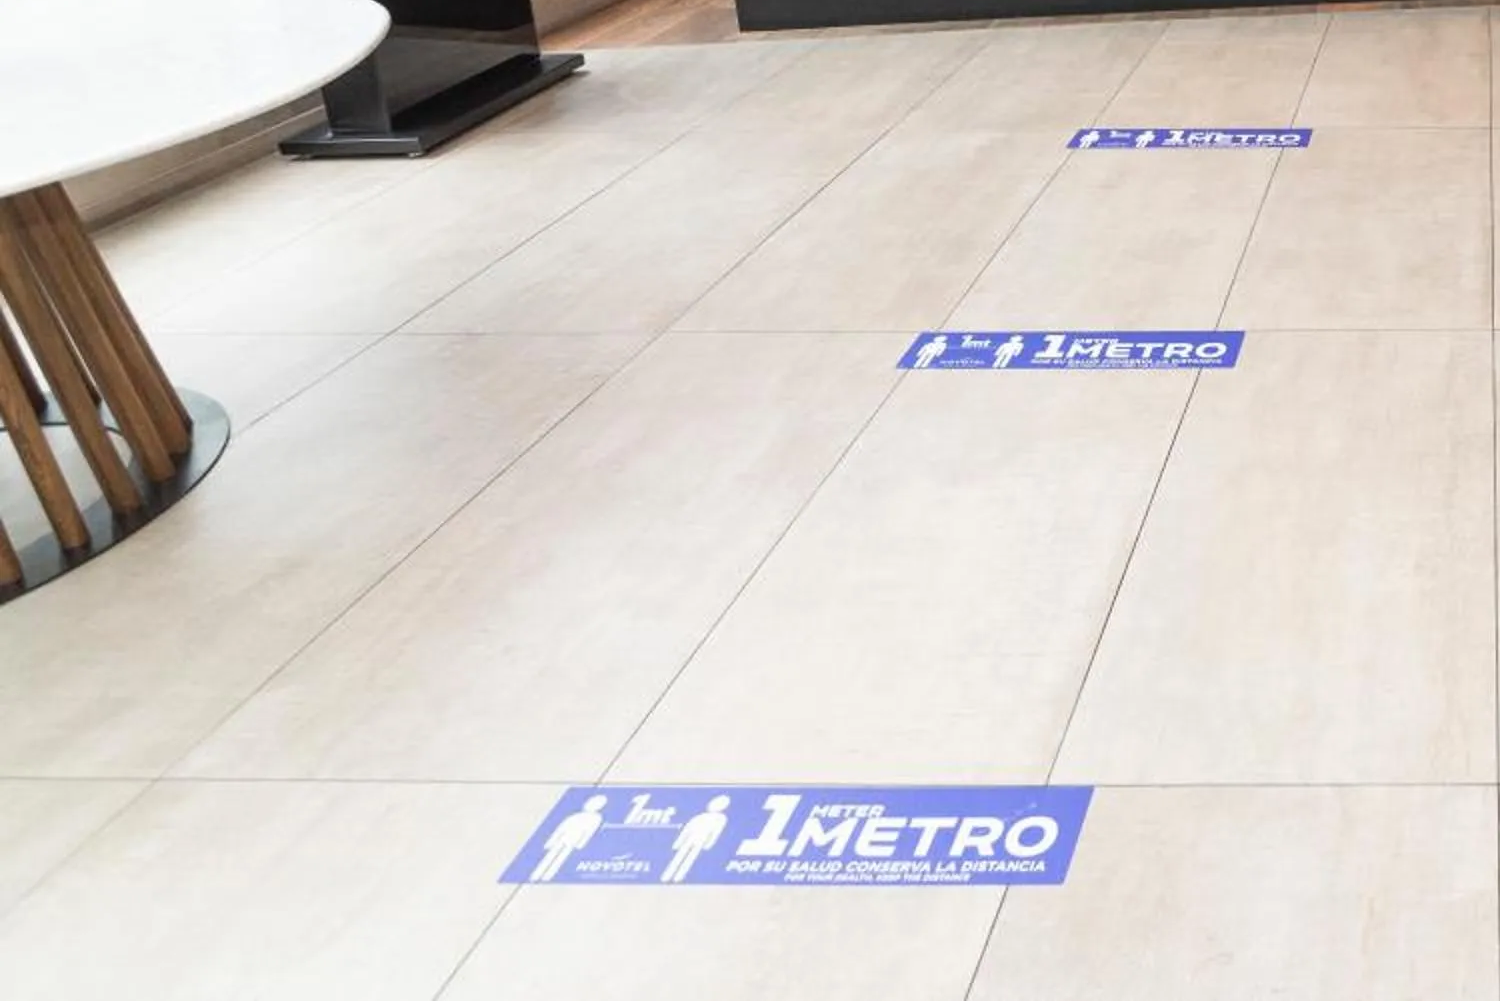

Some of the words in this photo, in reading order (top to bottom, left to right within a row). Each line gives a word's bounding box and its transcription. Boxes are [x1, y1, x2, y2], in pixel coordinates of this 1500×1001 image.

[1187, 133, 1301, 146] METRO
[1033, 334, 1066, 359] 1
[1066, 342, 1227, 359] METRO
[623, 793, 677, 826] 1mt
[810, 804, 887, 818] METER
[736, 794, 802, 857] 1
[788, 816, 1060, 857] METRO
[576, 860, 652, 872] NOVOTEL
[726, 860, 761, 872] POR
[764, 860, 787, 872] SU
[789, 860, 843, 872] SALUD
[846, 860, 931, 872] CONSERVA
[936, 860, 957, 872] LA
[960, 860, 1045, 872] DISTANCIA
